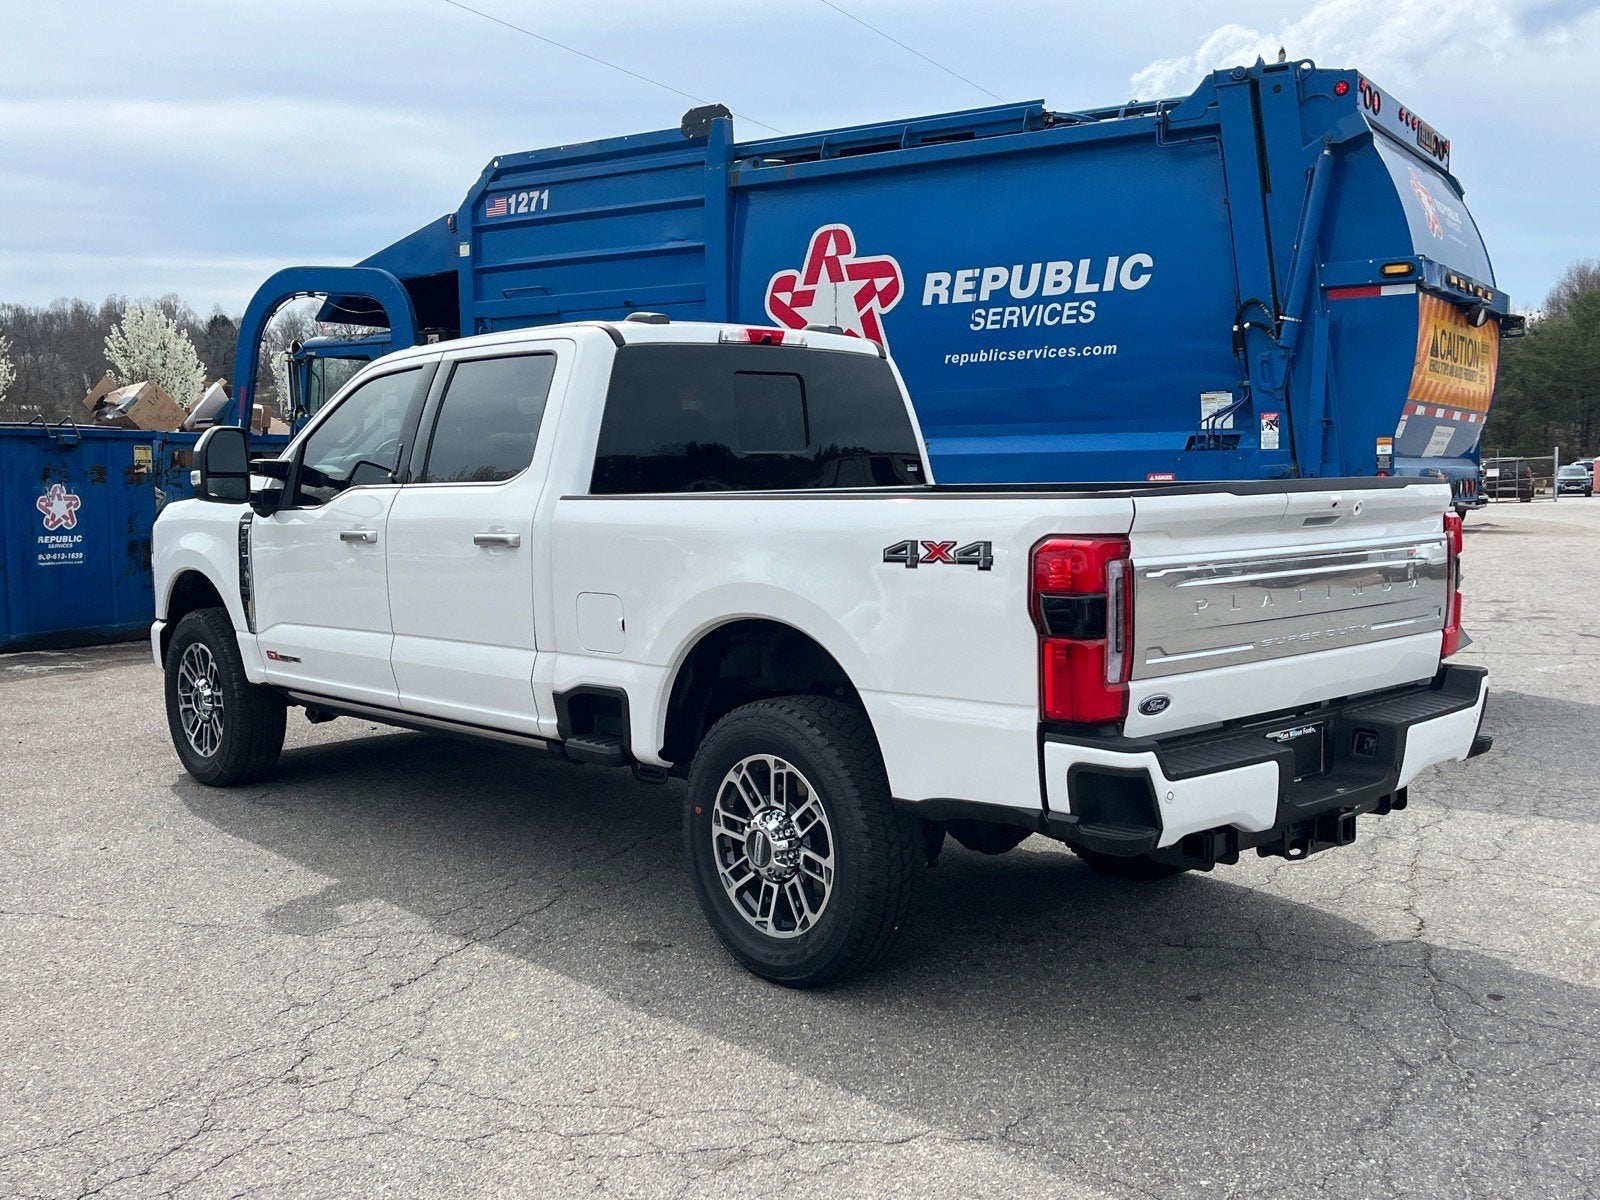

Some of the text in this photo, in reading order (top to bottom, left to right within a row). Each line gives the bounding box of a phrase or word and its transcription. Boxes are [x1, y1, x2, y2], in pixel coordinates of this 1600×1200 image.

[508, 189, 549, 215] 1271
[922, 252, 1154, 306] REPUBLIC
[969, 300, 1097, 331] SERVICES
[944, 344, 1118, 366] republicservices.com
[1440, 328, 1480, 369] CAUTION
[37, 534, 83, 544] REPUBLIC
[1193, 577, 1420, 616] PLATINUM
[1261, 624, 1367, 647] SUPER DUTY
